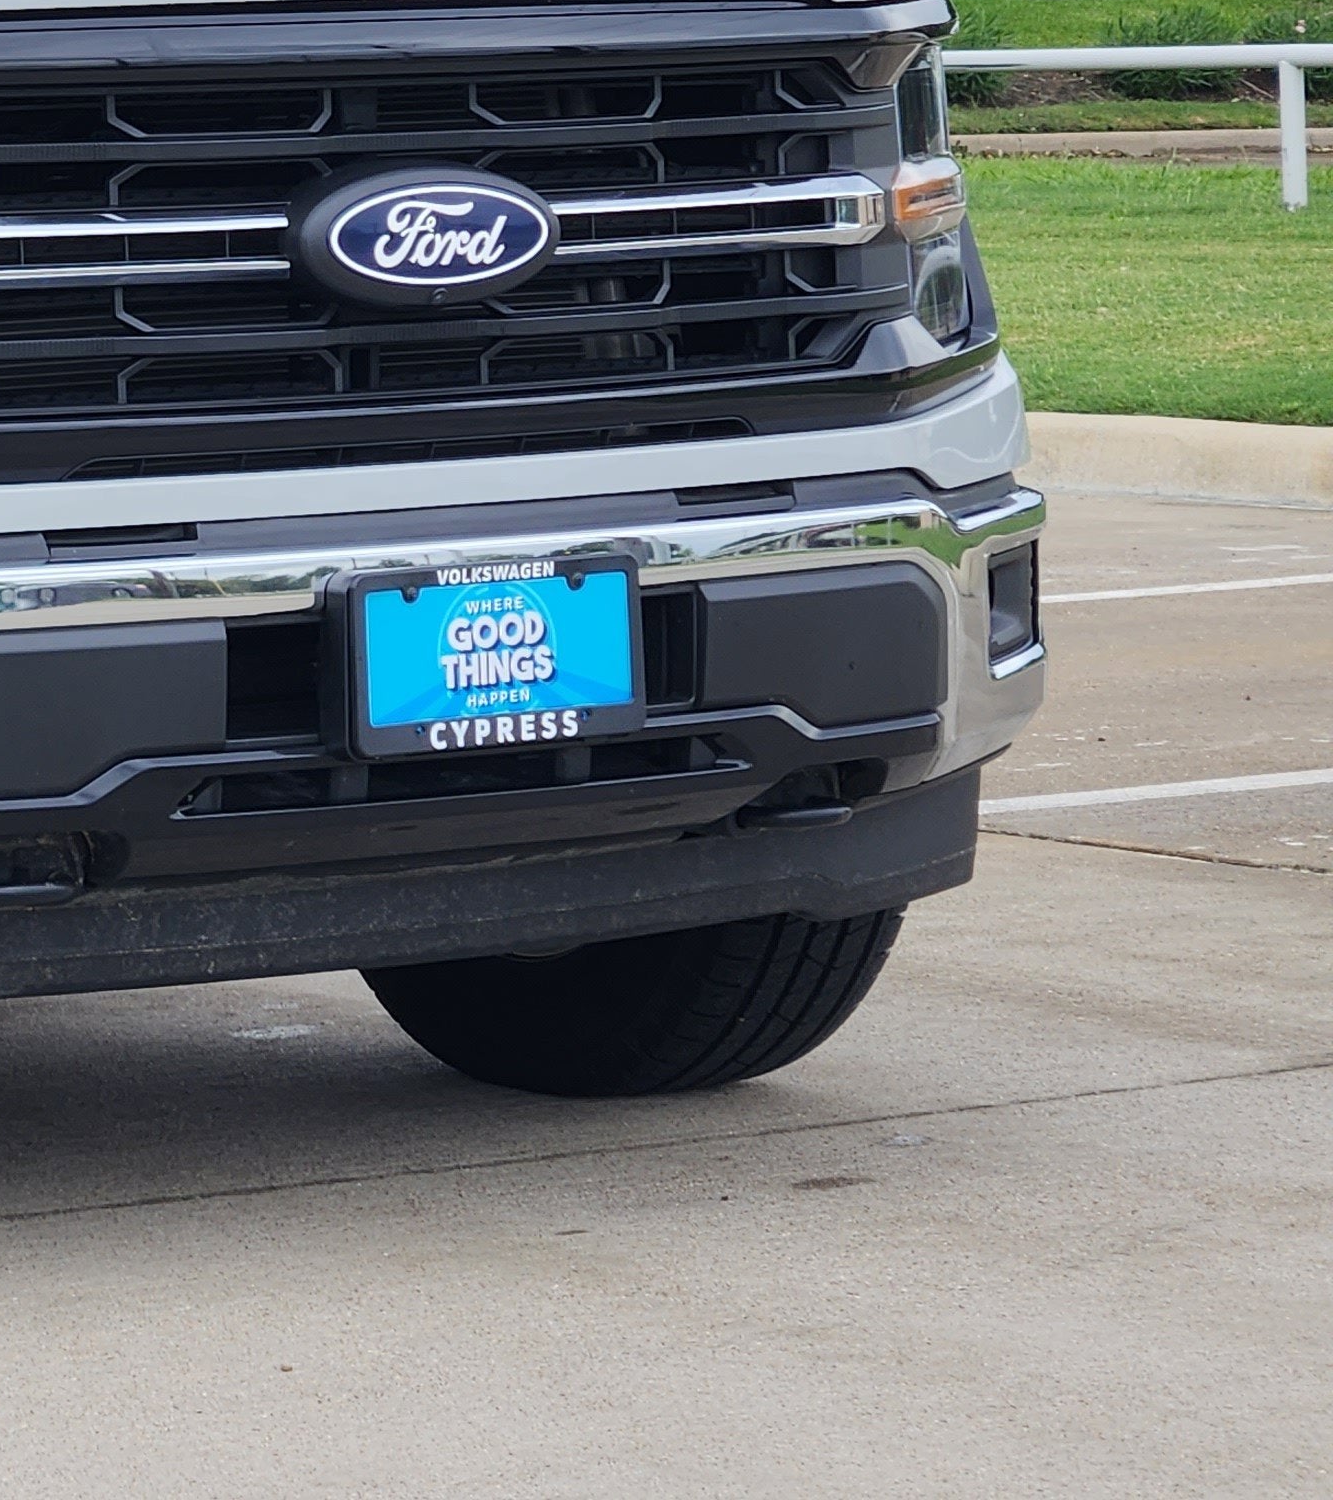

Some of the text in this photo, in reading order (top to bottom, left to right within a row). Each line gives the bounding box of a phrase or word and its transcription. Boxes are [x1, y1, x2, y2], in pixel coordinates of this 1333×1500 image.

[374, 201, 508, 269] Ford
[436, 560, 556, 587] VOLKSWAGEN
[464, 595, 526, 615] WHERE
[446, 609, 546, 652] GOOD
[440, 644, 555, 690] THINGS
[466, 688, 532, 709] HAPPEN
[429, 709, 579, 751] CYPRESS
